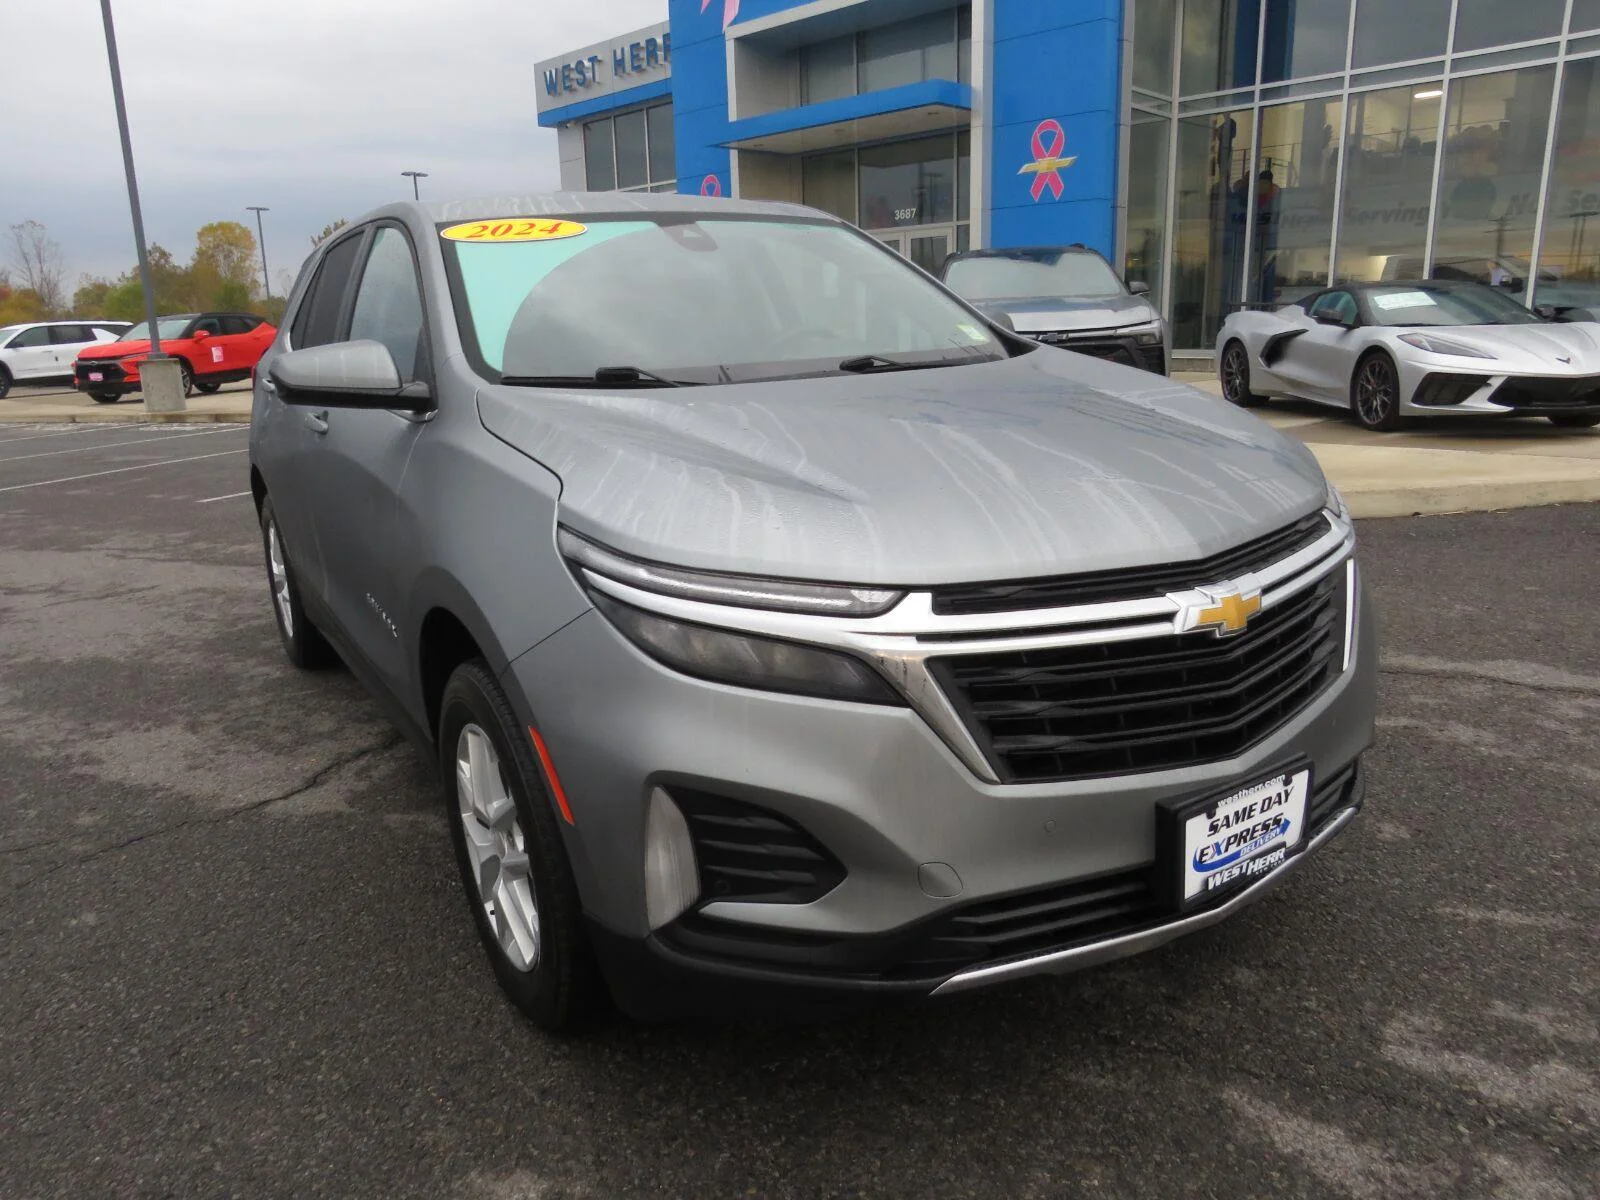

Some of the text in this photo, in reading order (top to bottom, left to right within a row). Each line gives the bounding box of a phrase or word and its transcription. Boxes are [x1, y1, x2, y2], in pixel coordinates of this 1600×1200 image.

[543, 55, 598, 97] WEST
[466, 222, 562, 239] 2024
[894, 207, 917, 220] 3687
[1207, 786, 1295, 837] SAME DAY
[1199, 813, 1284, 863] EXPRESS
[1239, 827, 1283, 856] DELIVERY
